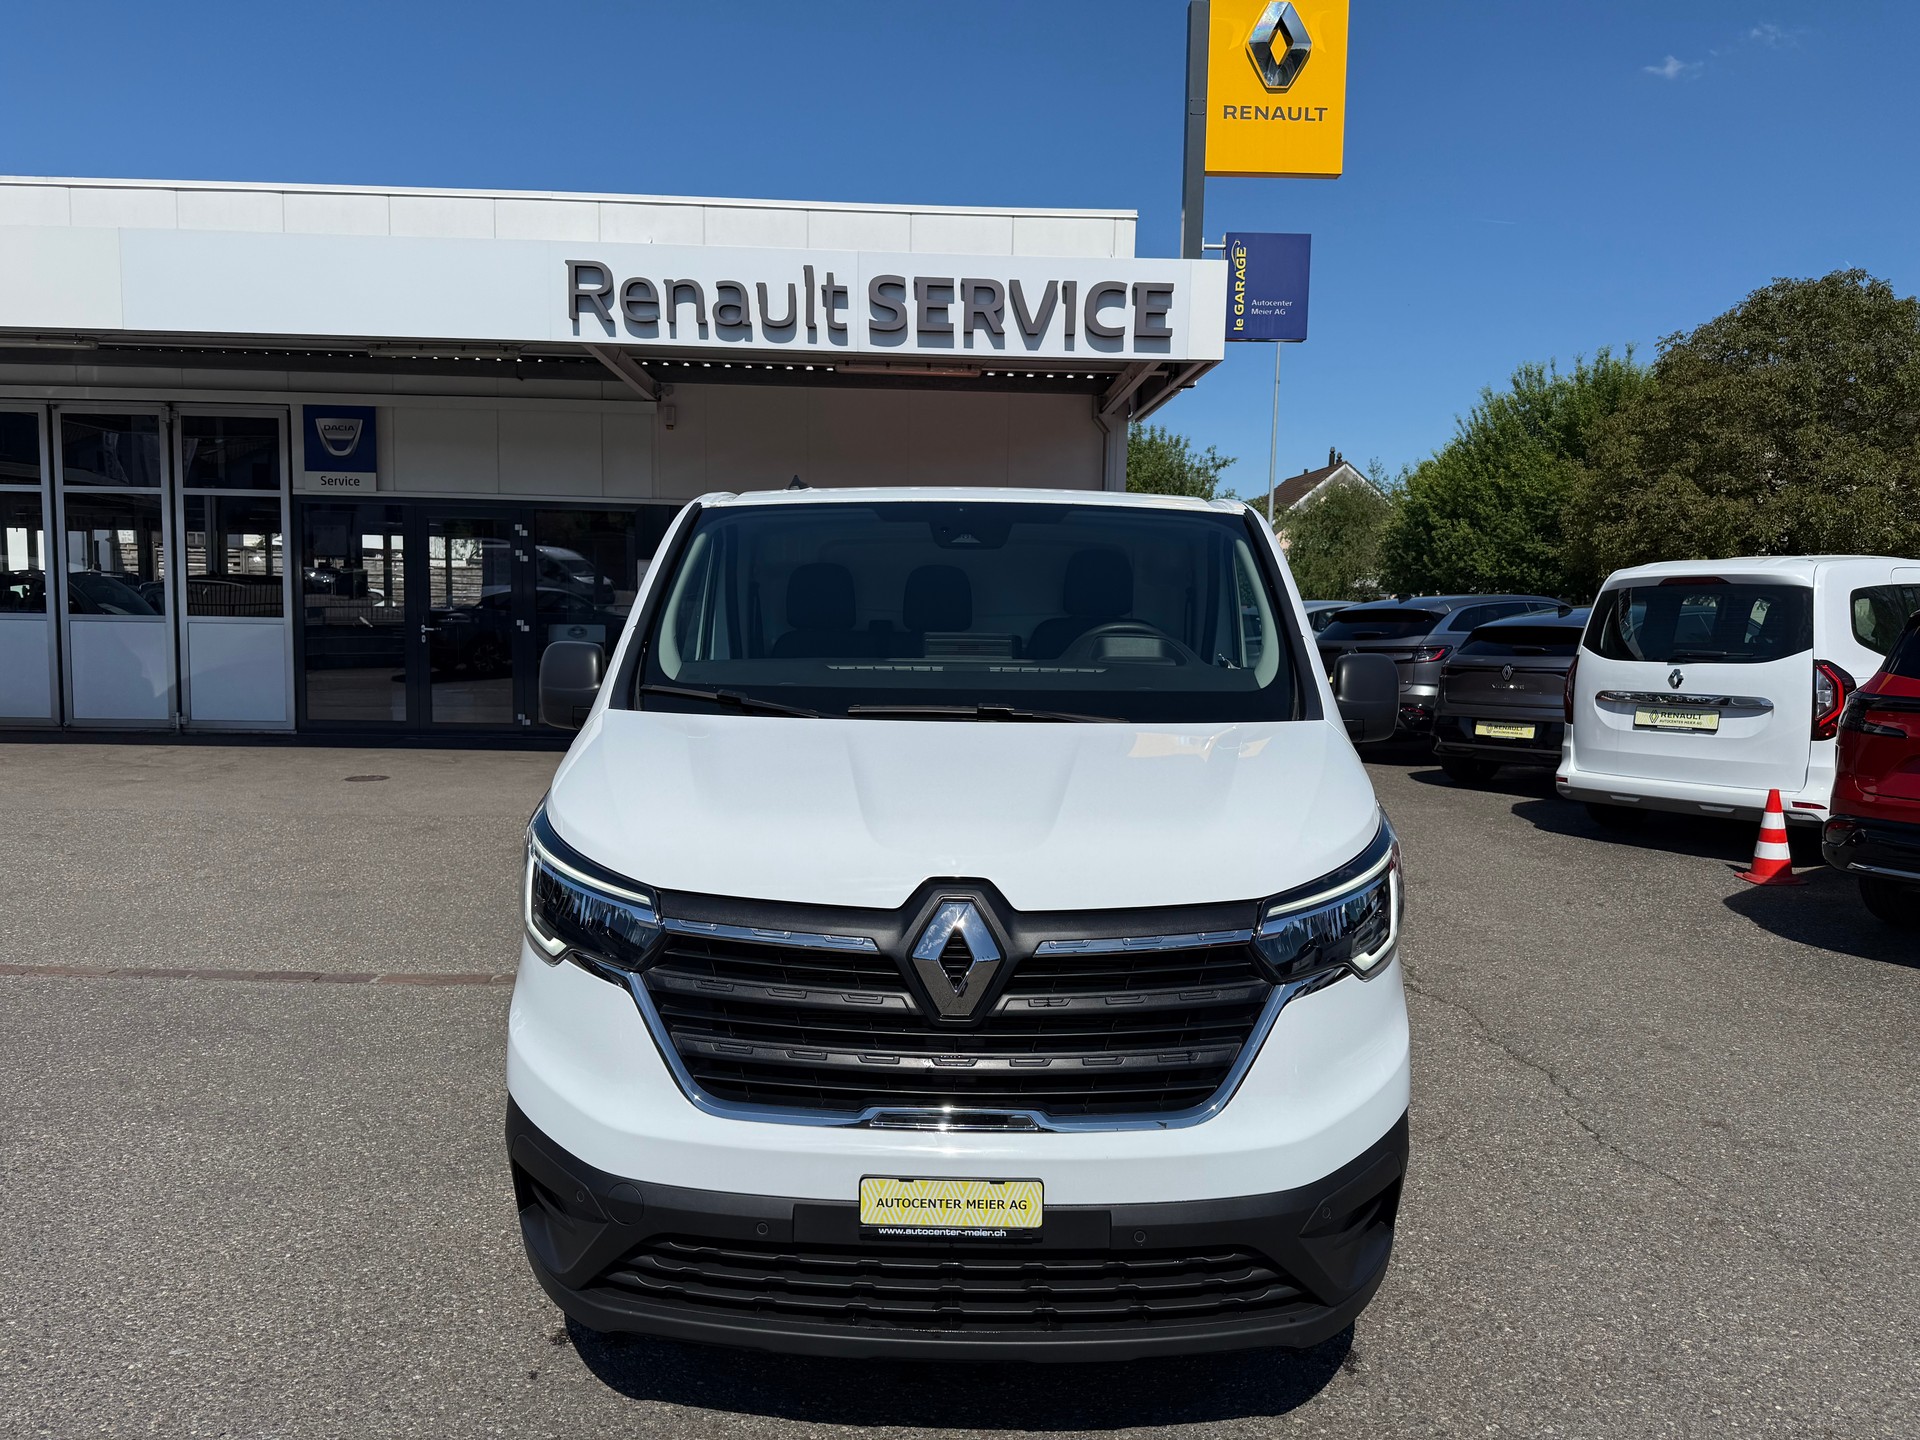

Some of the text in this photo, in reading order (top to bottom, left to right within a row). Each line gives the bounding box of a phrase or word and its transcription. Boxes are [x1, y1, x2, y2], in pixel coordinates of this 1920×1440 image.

[1223, 104, 1328, 122] RENAULT
[1233, 246, 1247, 331] le GARAGE
[564, 259, 1175, 338] Renault SERVICE
[1251, 299, 1293, 307] Autocenter
[1274, 308, 1286, 316] AG
[323, 424, 355, 432] DACIA
[320, 475, 360, 486] Service
[1660, 711, 1703, 720] RENAULT
[876, 1197, 1027, 1210] AUTOCENTER MEIER AG
[878, 1227, 1007, 1237] www.autocenter-meier.ch
